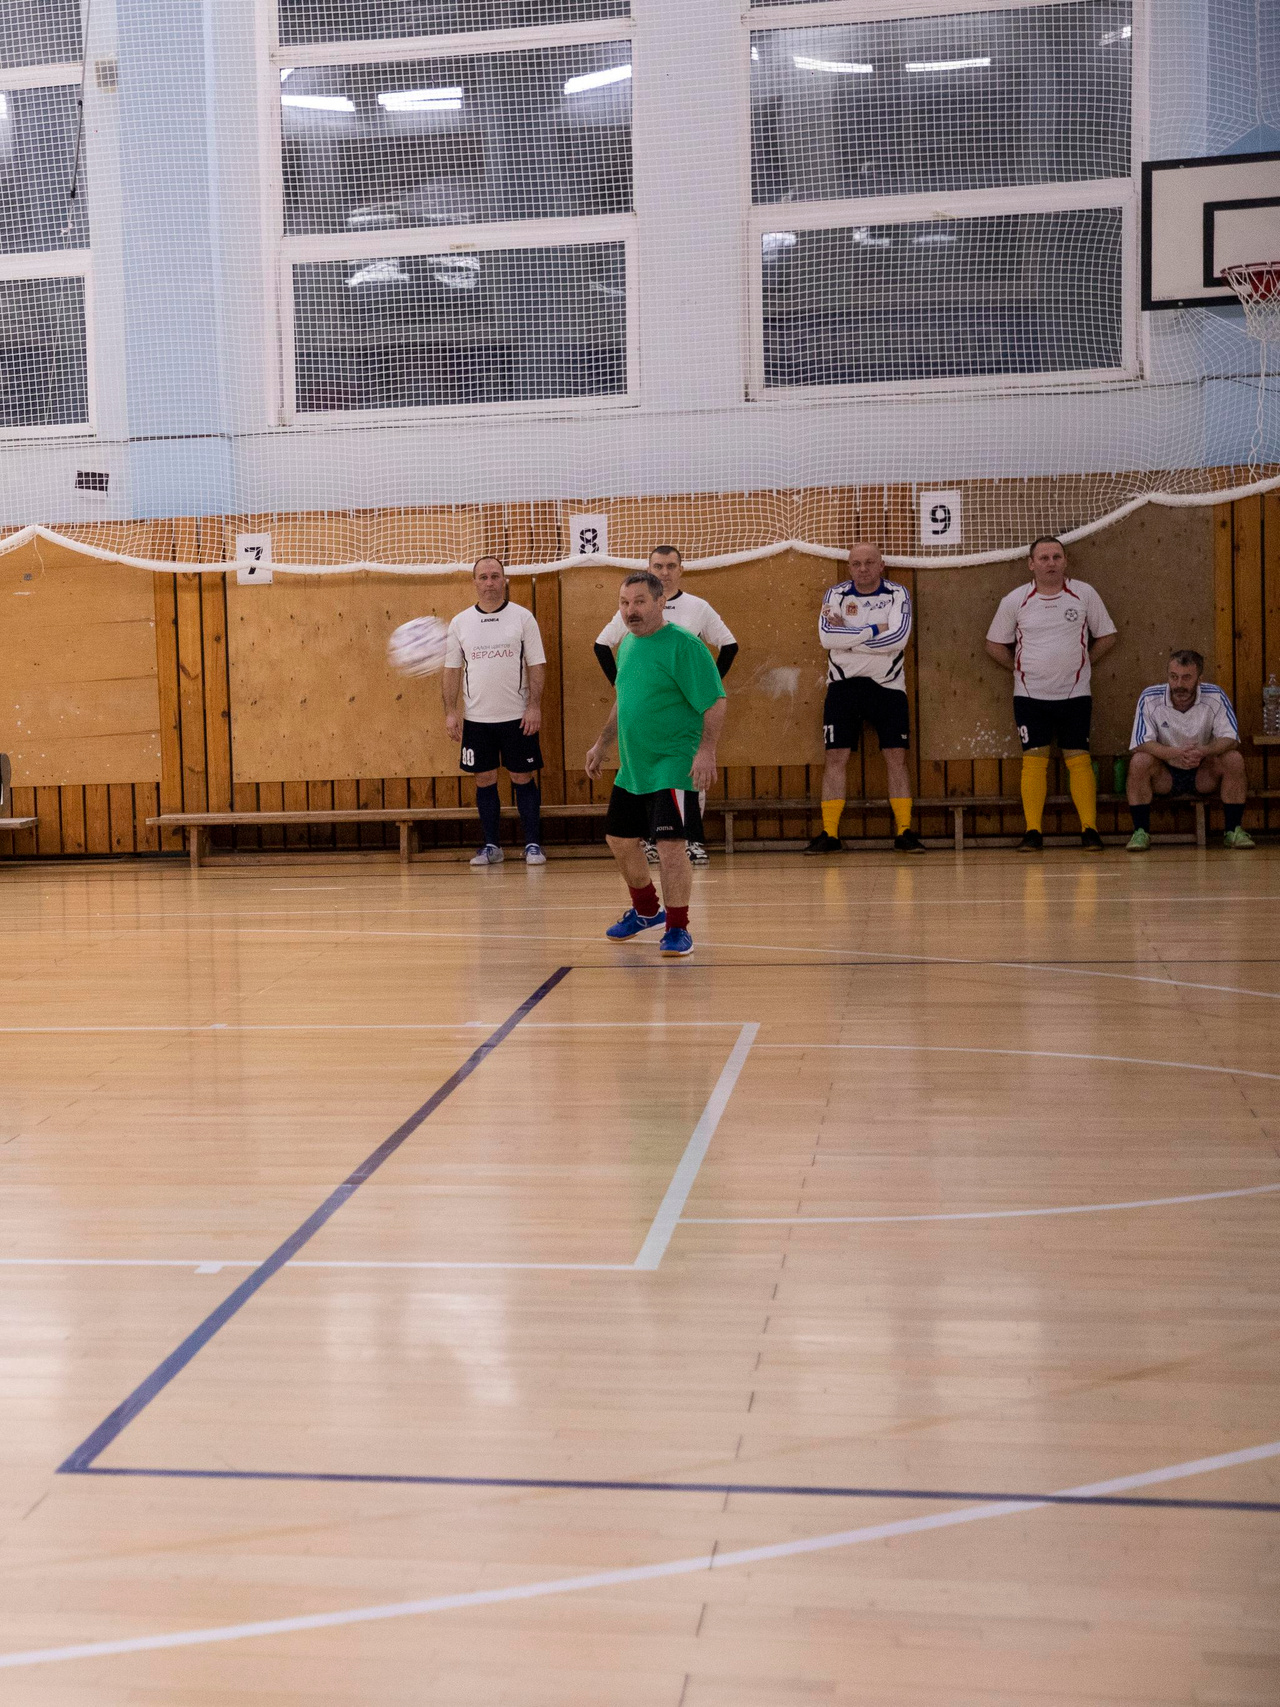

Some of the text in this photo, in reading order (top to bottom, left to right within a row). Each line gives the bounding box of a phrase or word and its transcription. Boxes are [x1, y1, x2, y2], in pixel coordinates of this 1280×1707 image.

[929, 504, 951, 535] 9
[579, 528, 600, 554] 8
[244, 546, 263, 575] 7
[462, 747, 475, 767] 80
